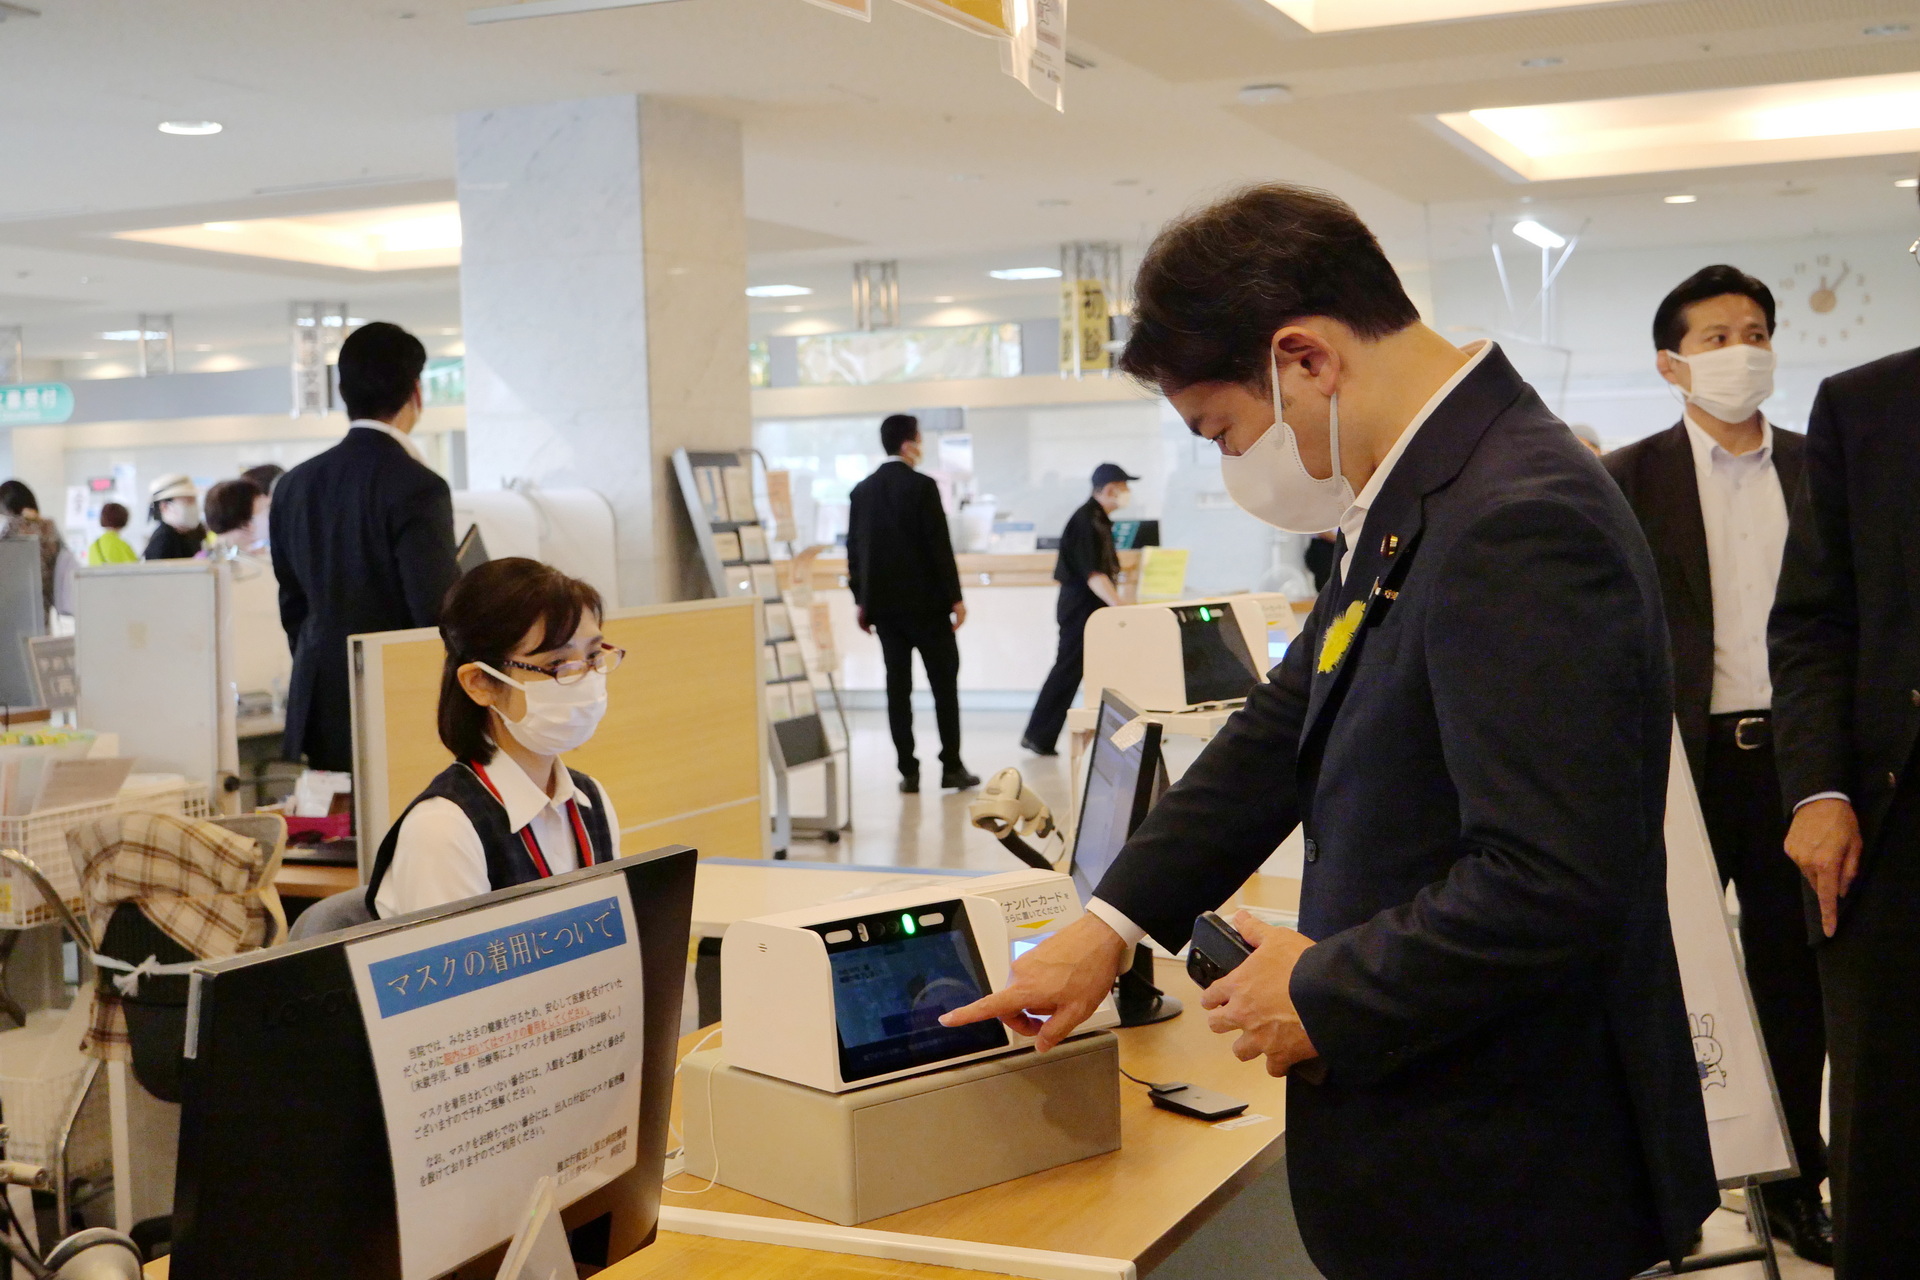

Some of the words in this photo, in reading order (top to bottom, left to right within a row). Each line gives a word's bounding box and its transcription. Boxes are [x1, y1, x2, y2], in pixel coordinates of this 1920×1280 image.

[1000, 891, 1069, 912] ナンバーカードを
[387, 911, 612, 996] マスクの着用について
